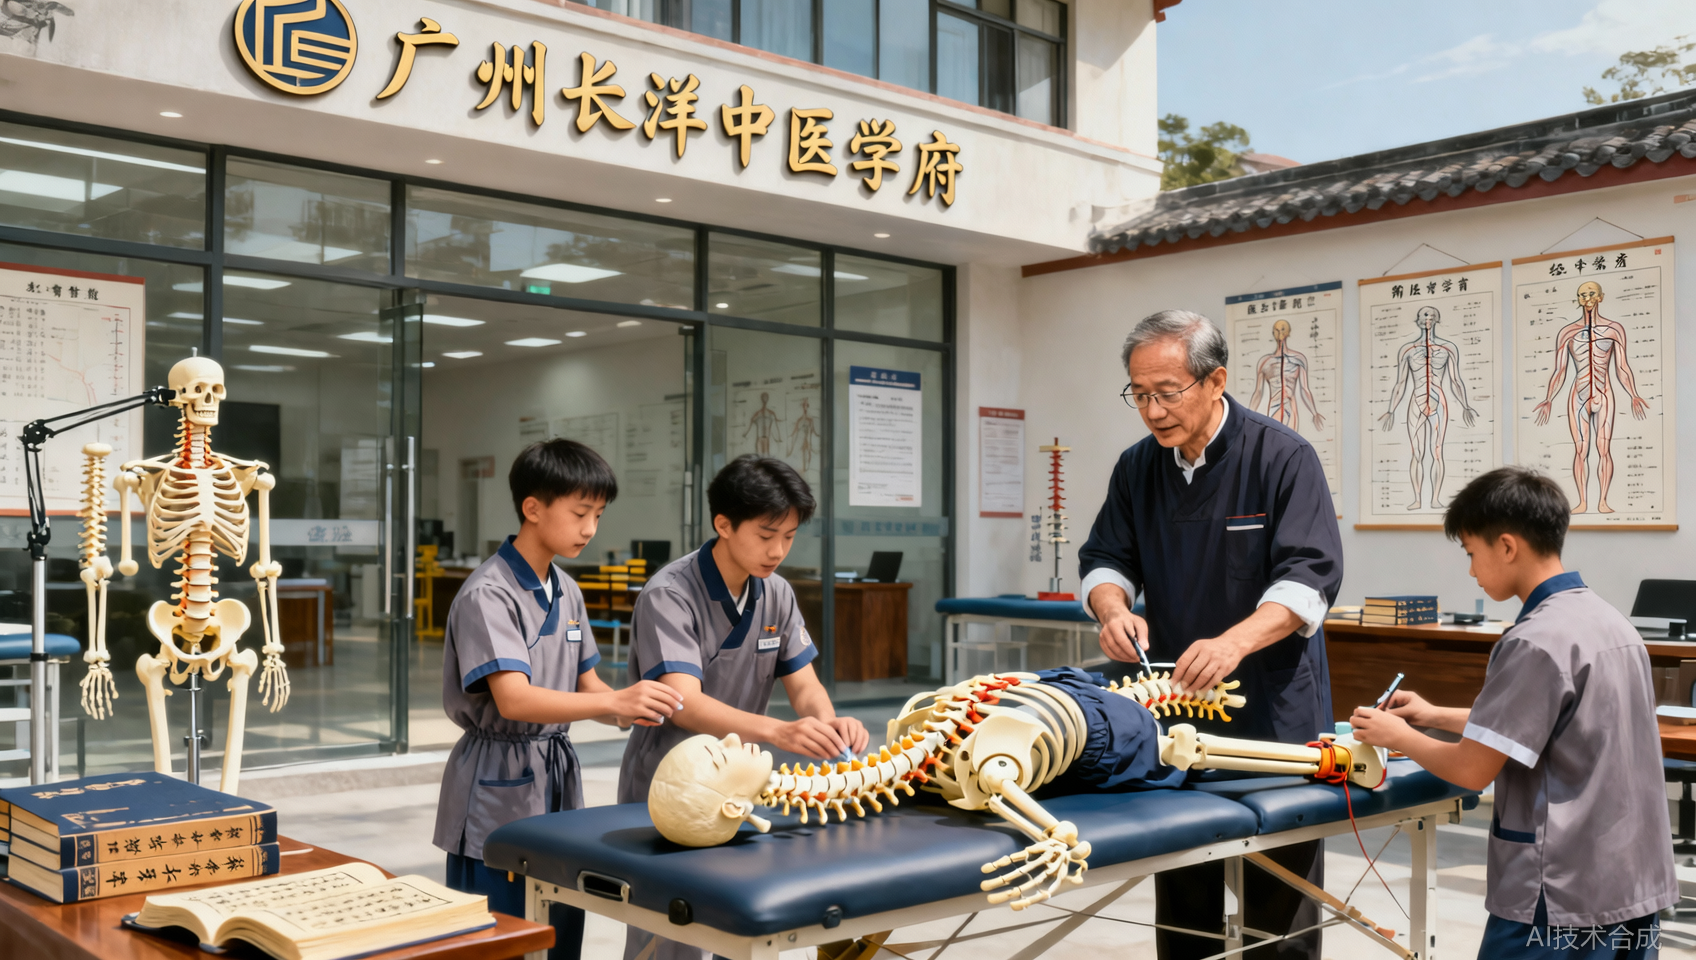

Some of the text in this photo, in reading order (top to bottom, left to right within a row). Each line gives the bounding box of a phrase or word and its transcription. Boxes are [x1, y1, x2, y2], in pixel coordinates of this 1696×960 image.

[375, 17, 963, 206] 广州长洋中医学府
